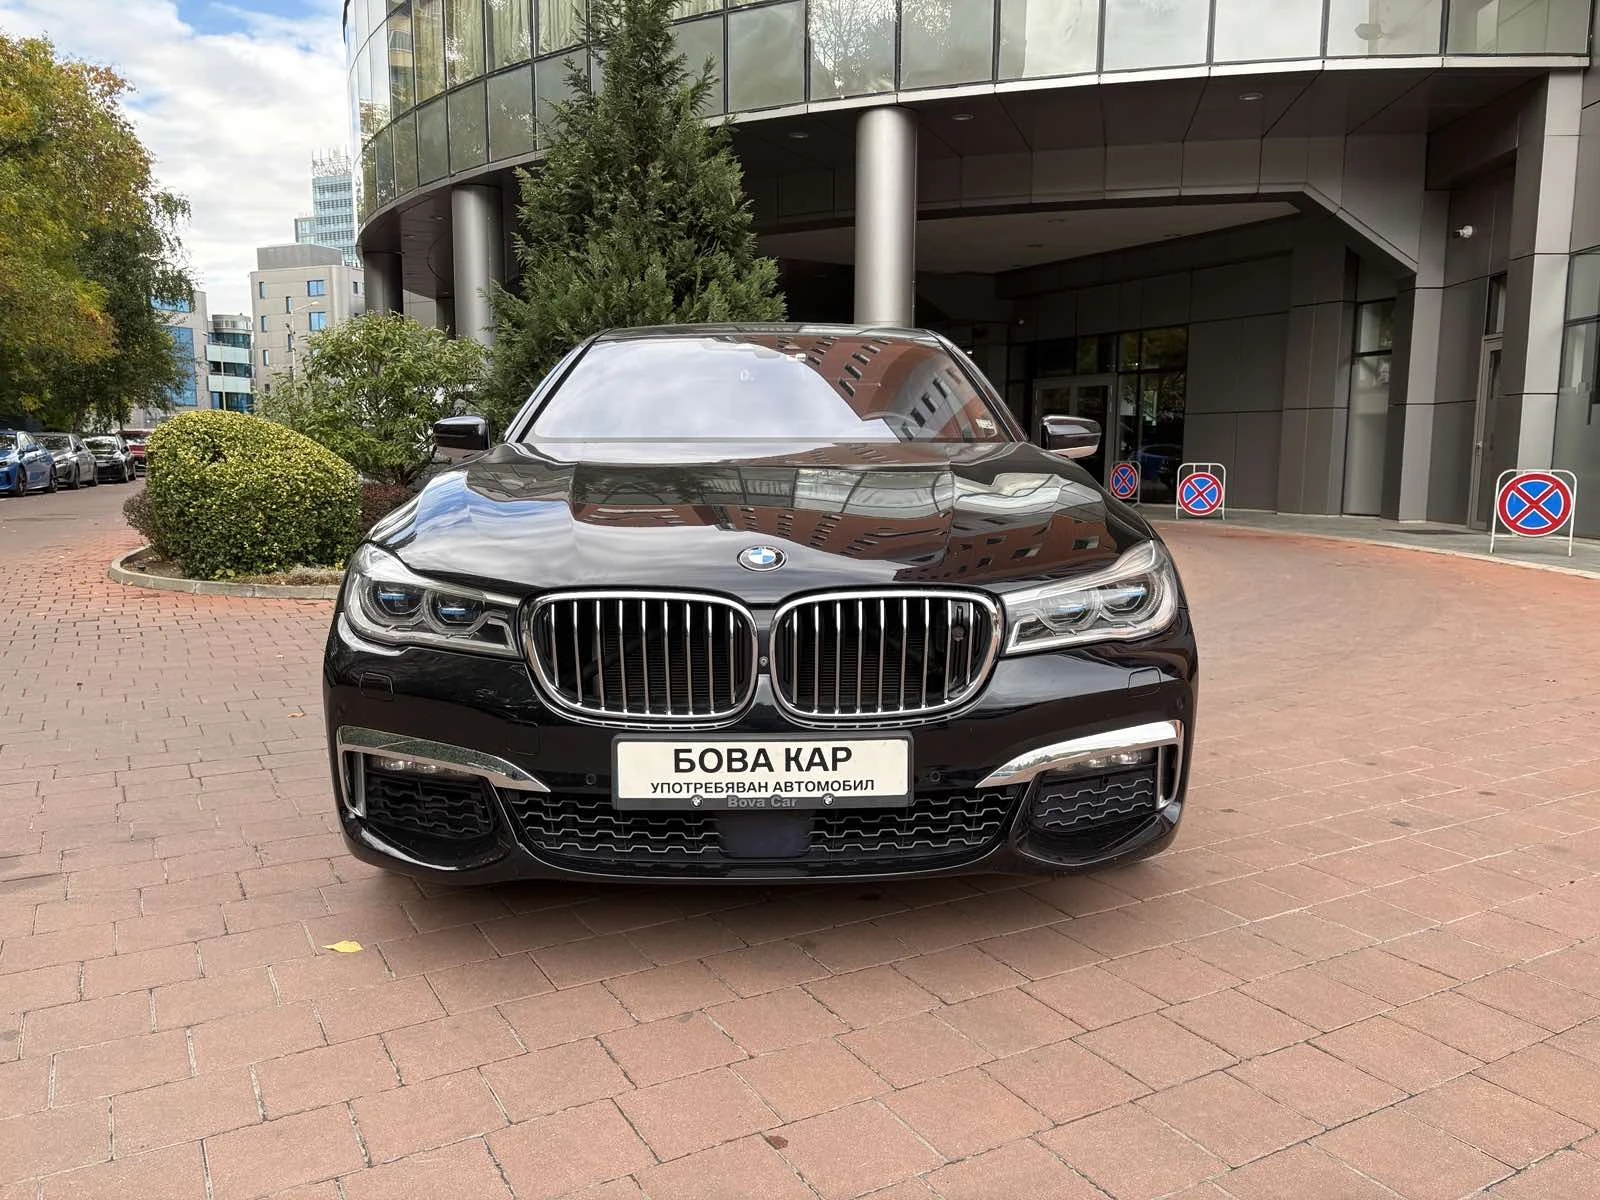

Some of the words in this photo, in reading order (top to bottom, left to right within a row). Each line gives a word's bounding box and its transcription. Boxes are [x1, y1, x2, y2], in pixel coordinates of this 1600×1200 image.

[673, 748, 775, 773] БОВА
[784, 747, 852, 773] КАР
[650, 782, 768, 794] УПОТРЕБЯВАН
[772, 779, 875, 793] АВТОМОБИЛ
[727, 796, 765, 808] Bova
[770, 795, 798, 808] Car
